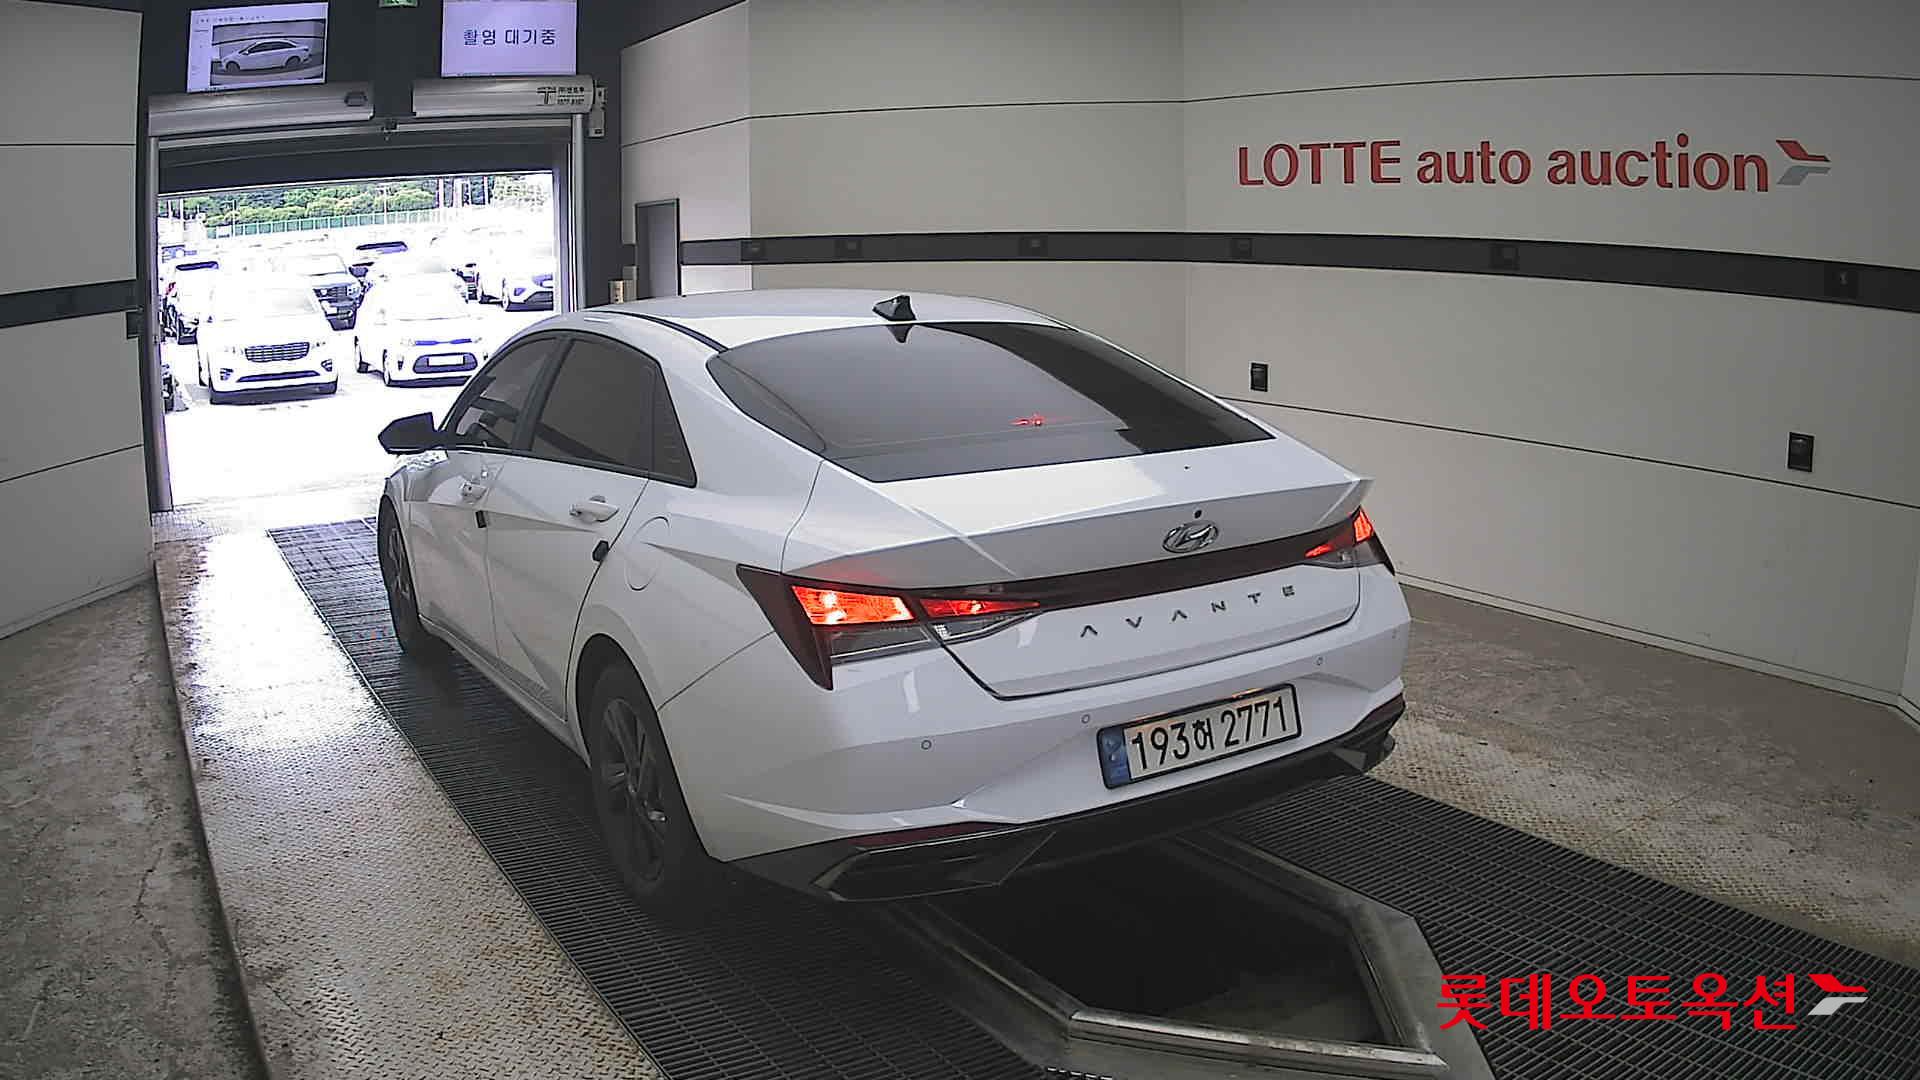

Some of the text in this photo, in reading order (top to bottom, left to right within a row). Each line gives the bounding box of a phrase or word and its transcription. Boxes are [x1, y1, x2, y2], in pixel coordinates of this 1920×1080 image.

[464, 29, 556, 46] 촬영 대기중
[1238, 133, 1769, 193] LOTTE auto auction
[1080, 585, 1295, 638] AVANTE
[1131, 696, 1288, 770] 193허 2771
